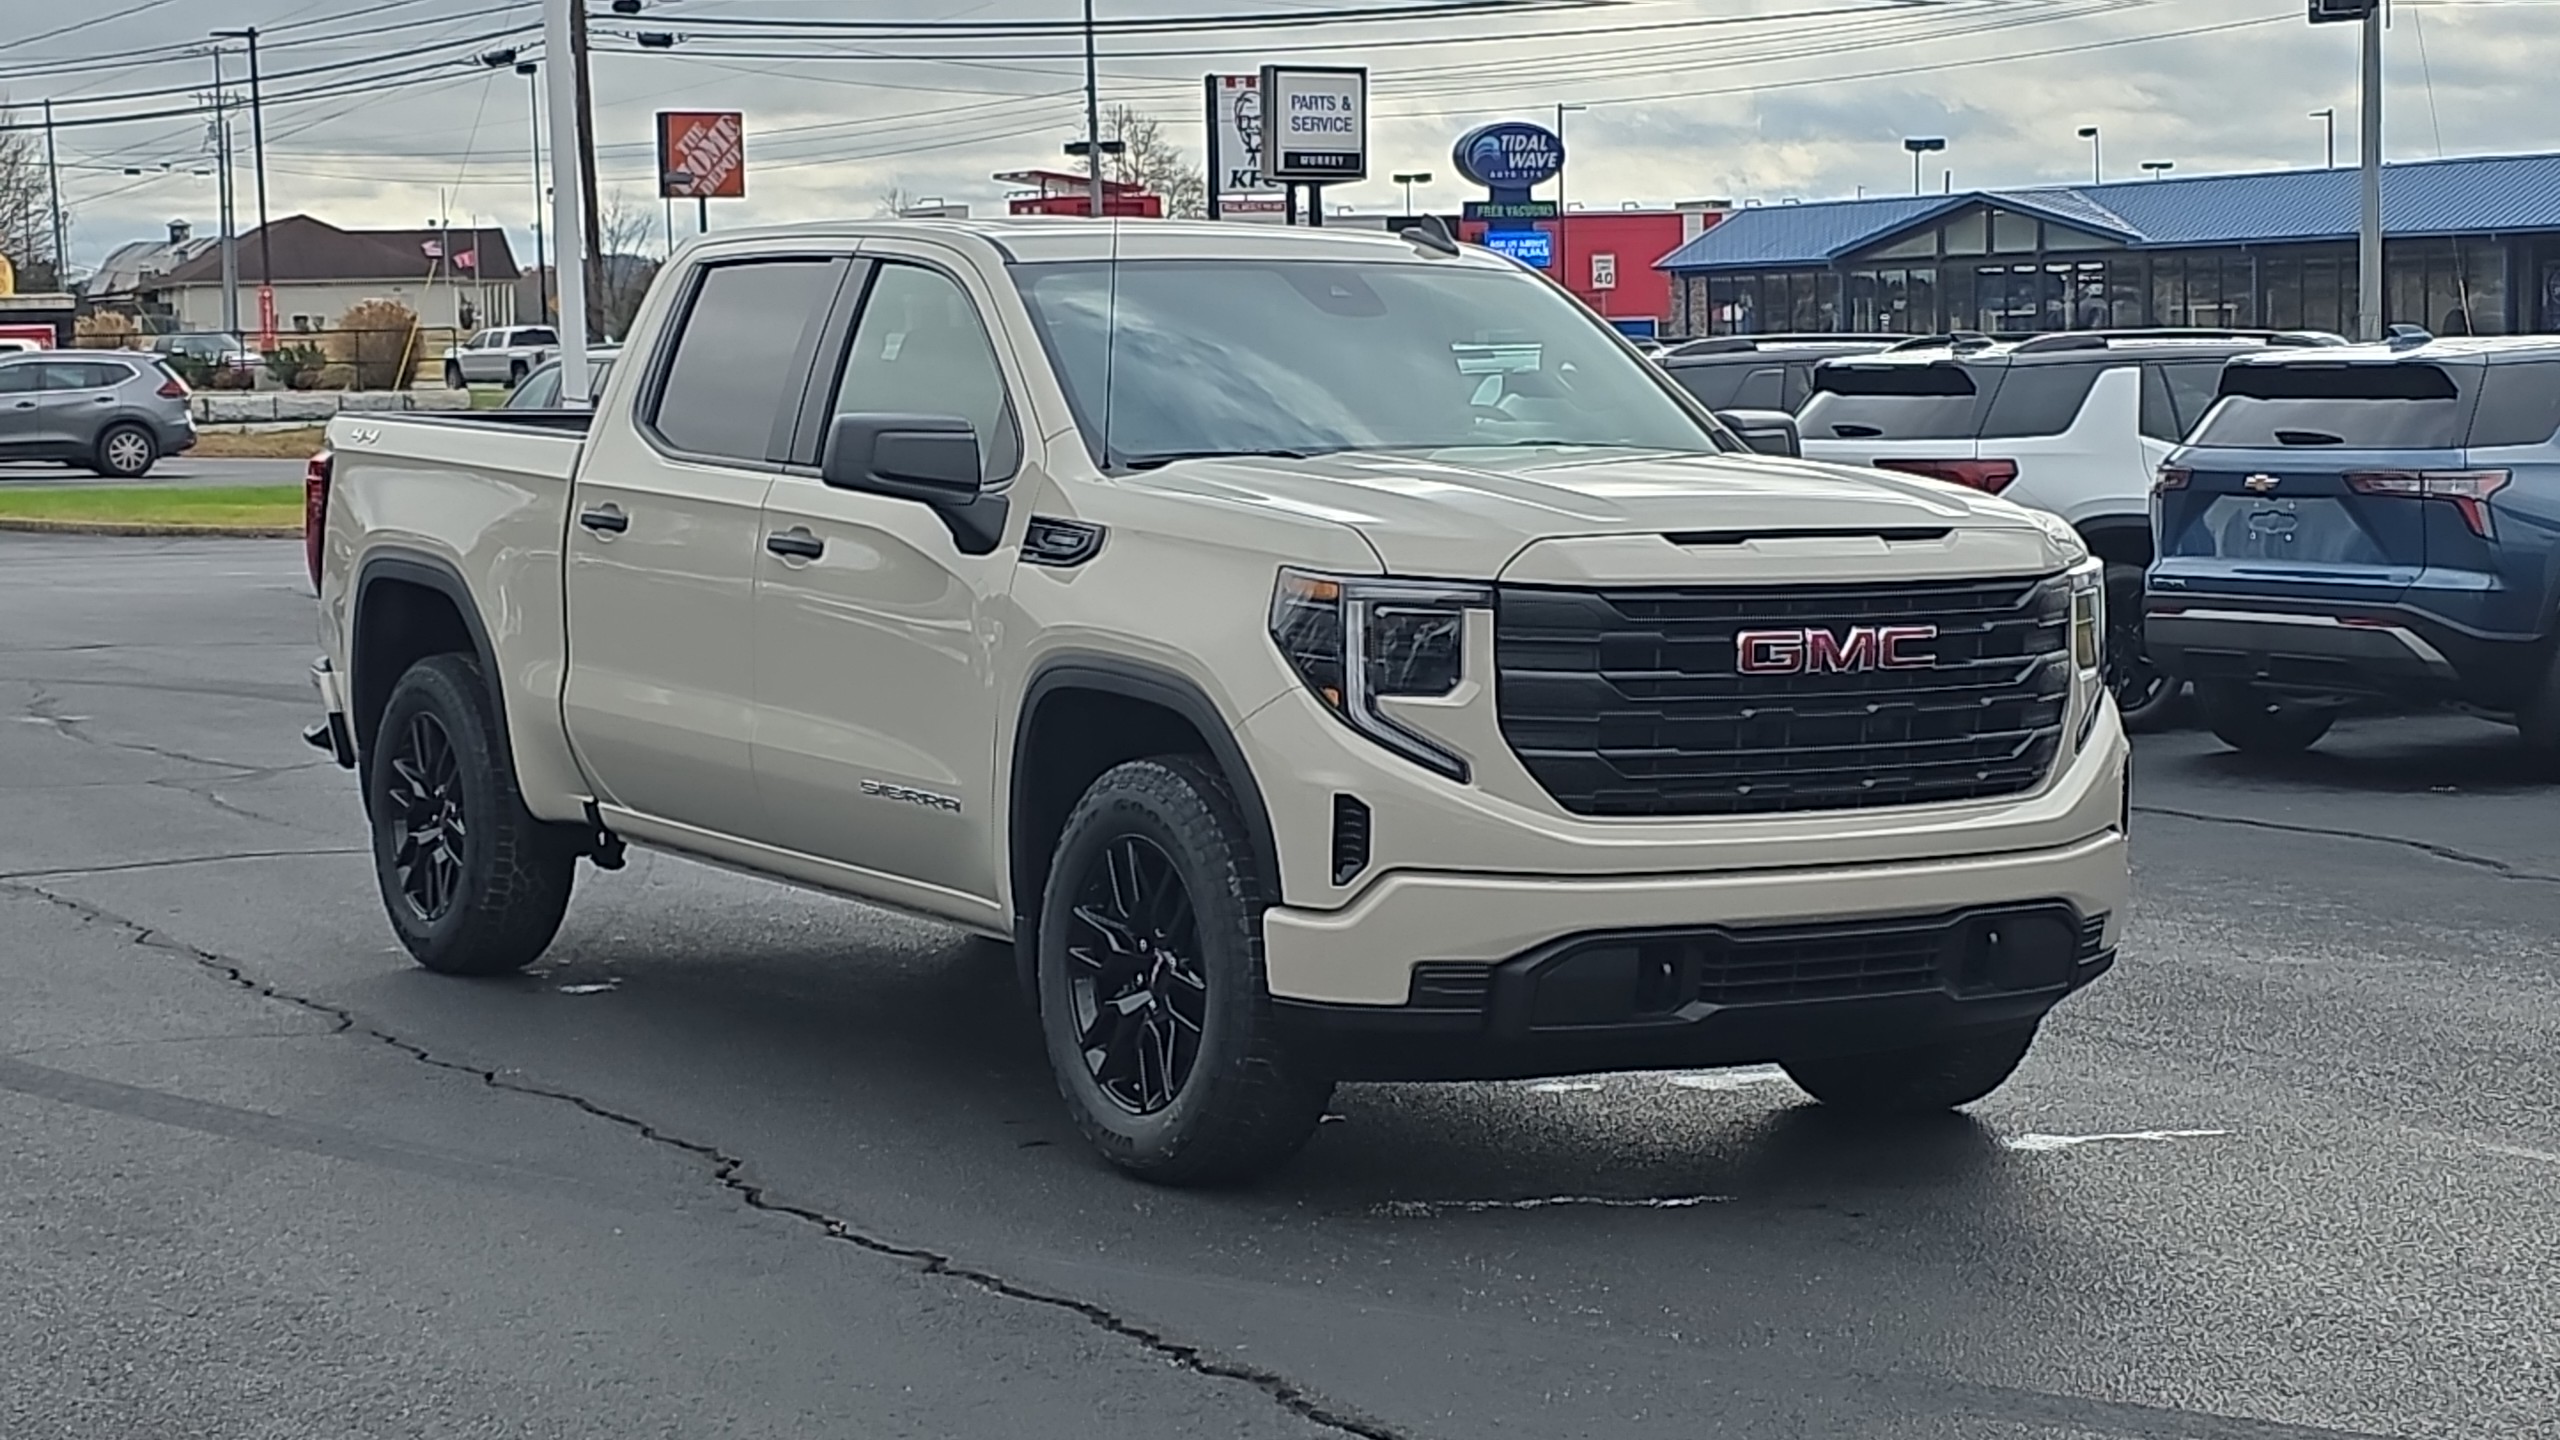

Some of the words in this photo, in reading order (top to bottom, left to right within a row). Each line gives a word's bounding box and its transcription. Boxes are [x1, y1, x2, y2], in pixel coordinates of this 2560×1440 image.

[1291, 95, 1336, 111] PARTS
[1341, 95, 1352, 111] &
[1291, 116, 1352, 132] SERVICE
[675, 121, 707, 155] THE
[1500, 134, 1548, 152] TIDAL
[669, 115, 740, 195] HOME
[1300, 155, 1343, 166] MURRAY
[1508, 152, 1558, 168] WAVE
[698, 144, 741, 195] DEPOT
[1594, 272, 1613, 285] 40
[1737, 625, 1938, 674] GMC
[859, 779, 961, 813] SIERRA
